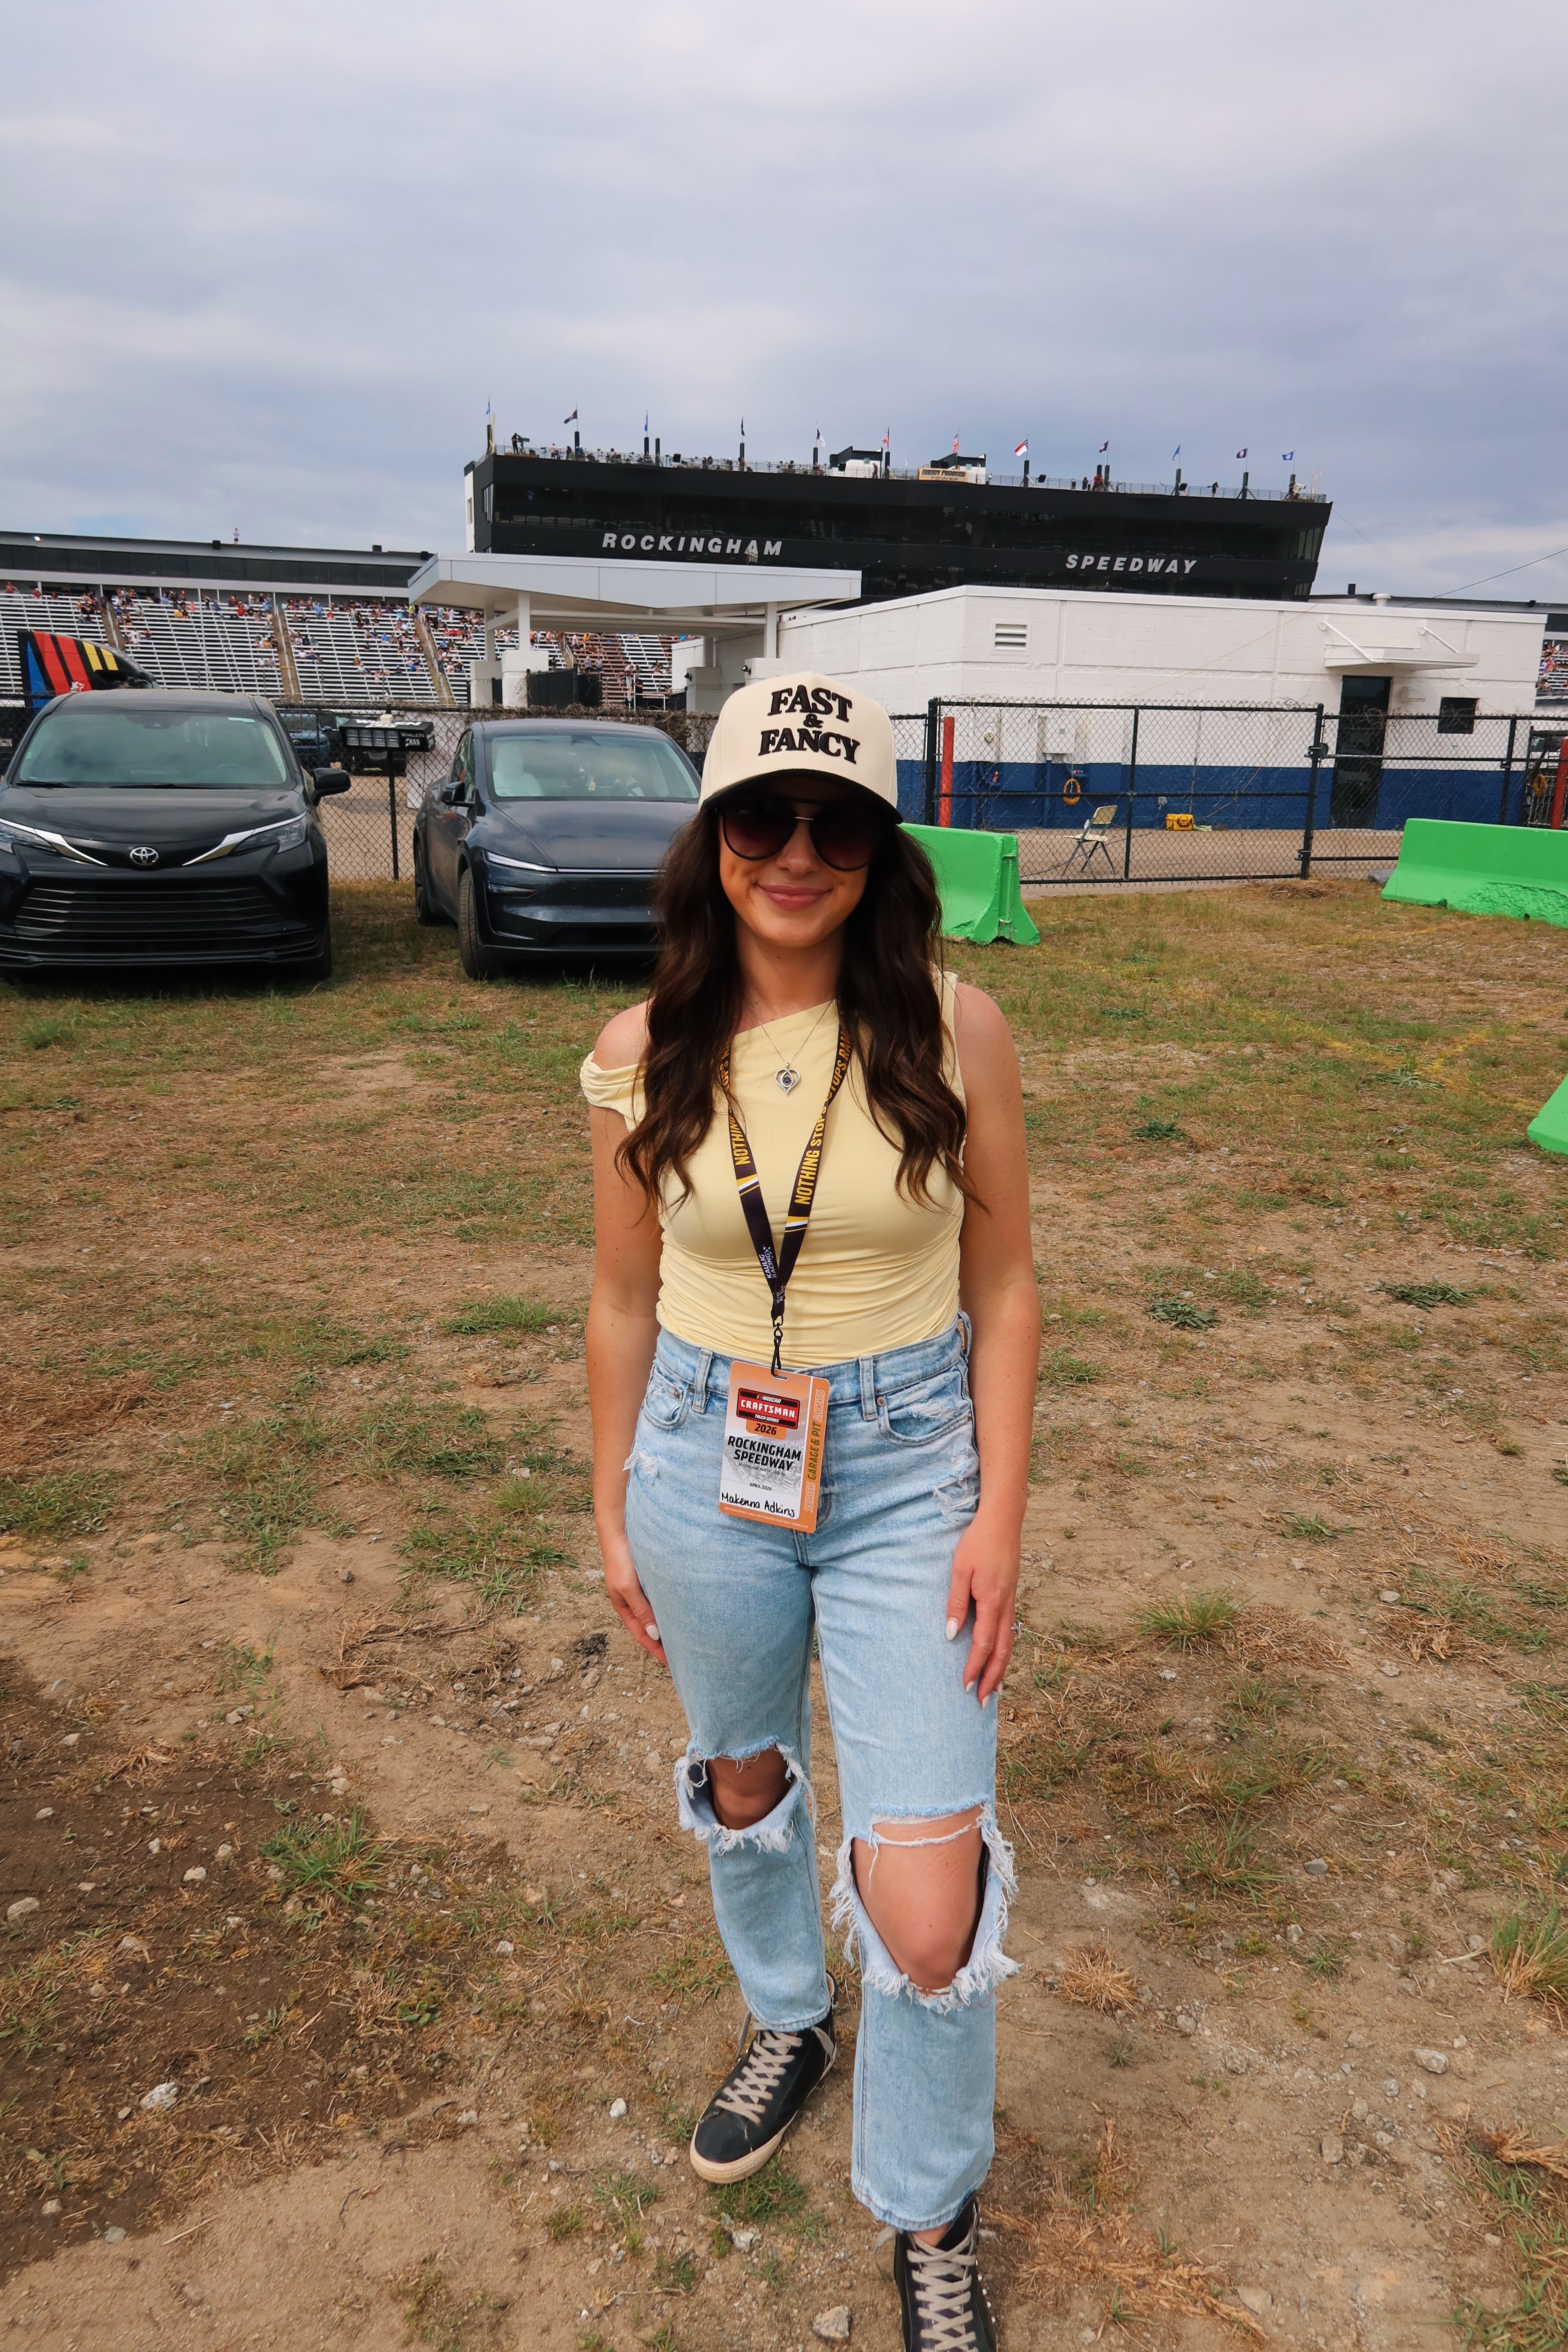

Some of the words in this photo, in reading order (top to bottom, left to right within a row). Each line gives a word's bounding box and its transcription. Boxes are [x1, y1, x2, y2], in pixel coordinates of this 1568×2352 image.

[602, 533, 783, 556] ROCKINGHAM
[1066, 554, 1197, 574] SPEEDWAY
[767, 684, 852, 723] FAST
[803, 713, 824, 729] &
[758, 728, 861, 764] FANCY
[794, 1150, 820, 1205] NOTHING
[811, 1106, 827, 1147] STOPS
[759, 1254, 772, 1278] KAULIG
[765, 1253, 778, 1278] RACING
[741, 1400, 795, 1418] CRAFTSMAN
[762, 1395, 781, 1404] NASCAR
[813, 1389, 825, 1423] ACCESS
[754, 1423, 777, 1435] 2026
[812, 1421, 821, 1437] PIT
[728, 1436, 802, 1461] ROCKINGHAM
[734, 1449, 793, 1471] SPEEDWAY
[808, 1446, 819, 1480] GARAGE
[721, 1492, 760, 1509] Makenna
[764, 1500, 795, 1517] Adkins
[804, 1482, 816, 1513] SERIES
